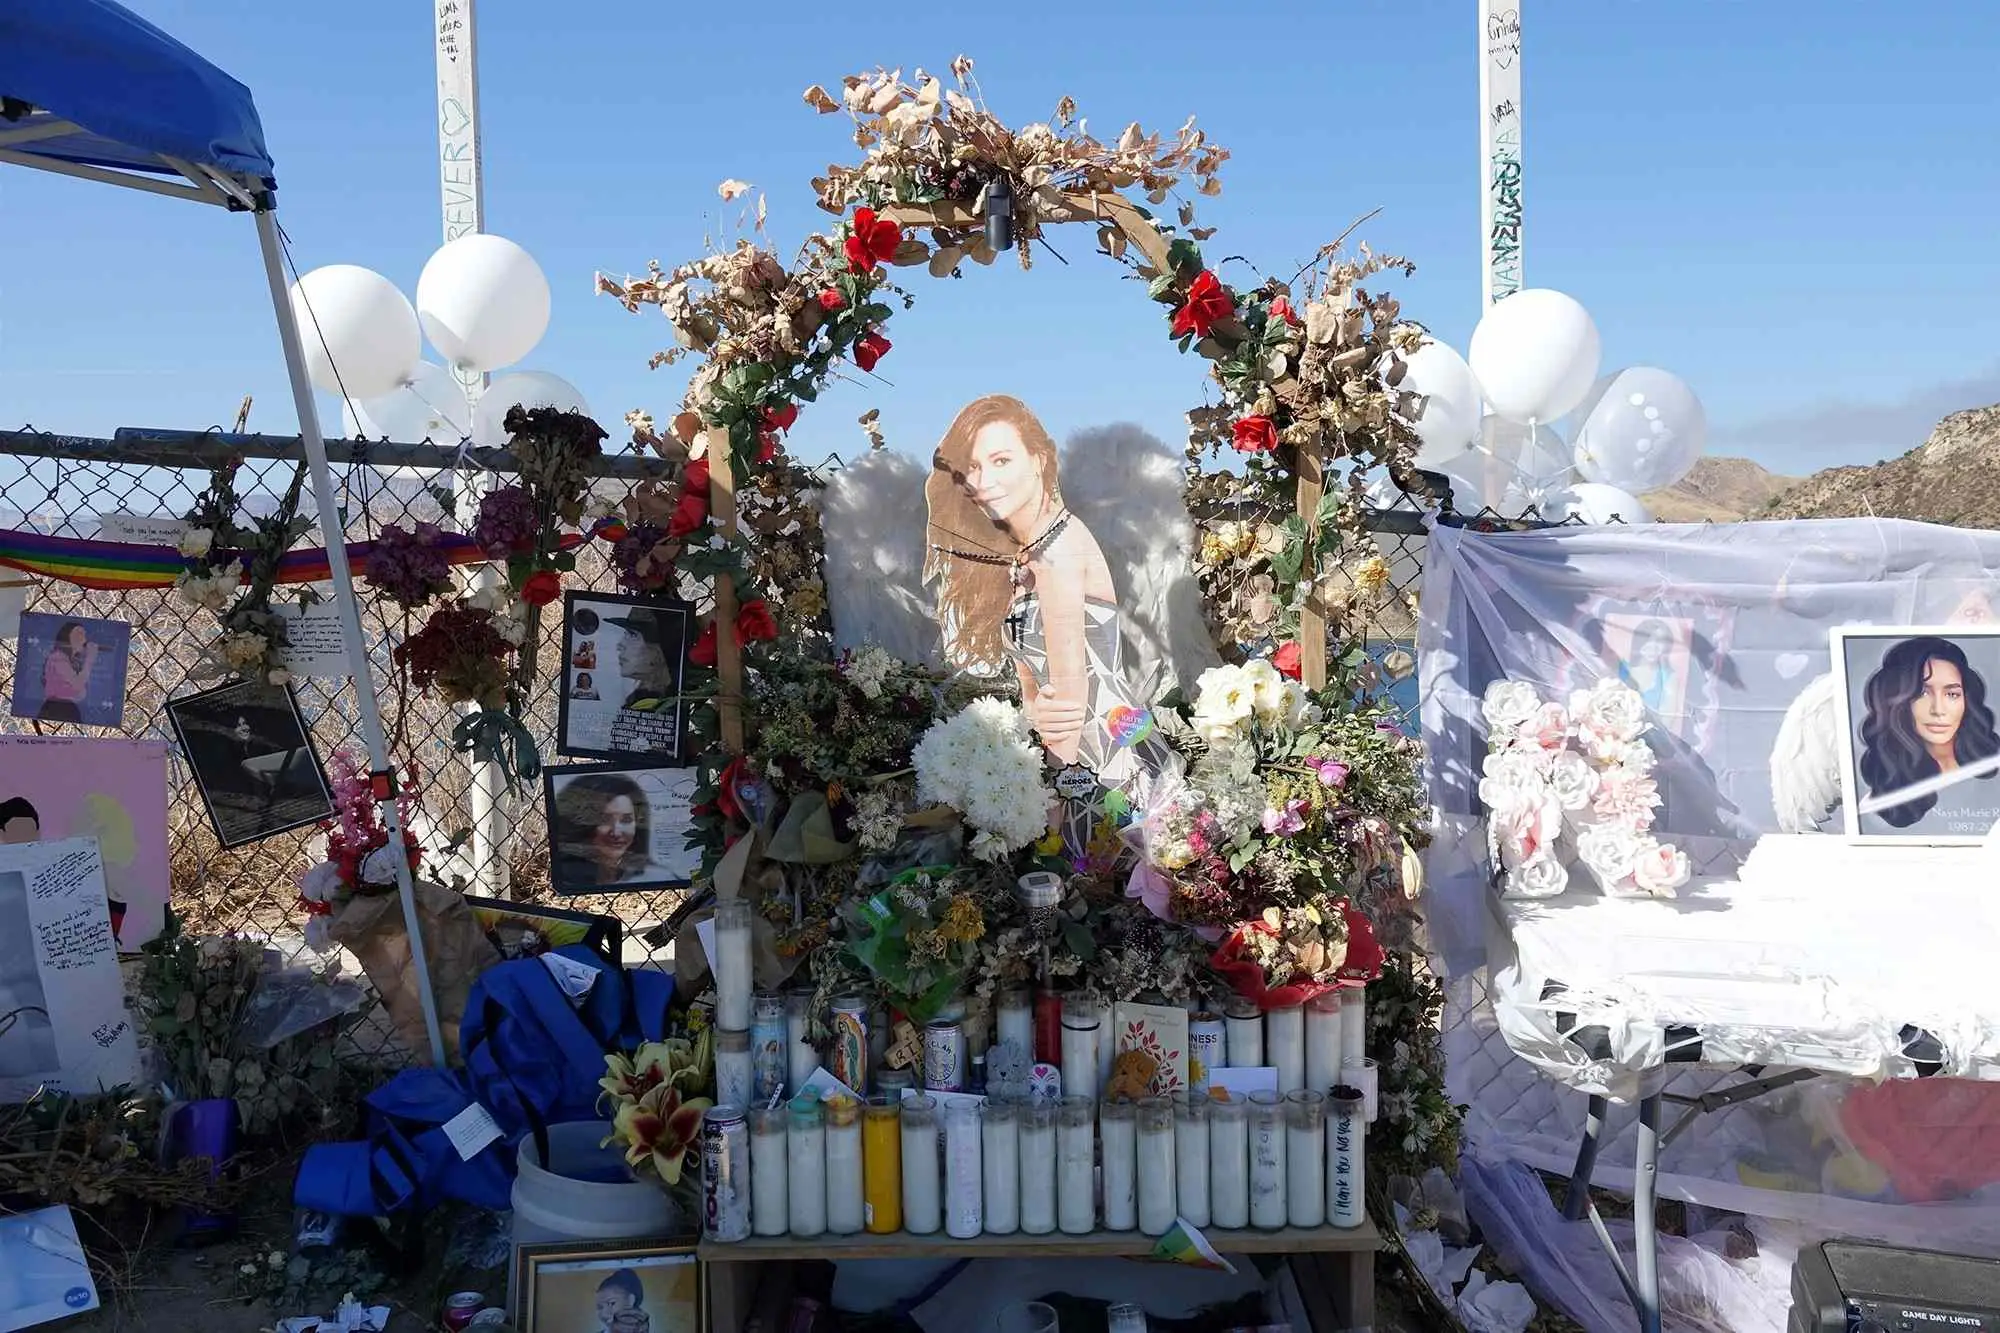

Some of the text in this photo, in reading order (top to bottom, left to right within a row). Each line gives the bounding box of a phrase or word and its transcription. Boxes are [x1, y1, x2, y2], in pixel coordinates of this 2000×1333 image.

[1061, 777, 1092, 785] HEROES
[1933, 806, 1959, 818] Naya
[1902, 1310, 1981, 1327] GAME DAY LIGHTS
